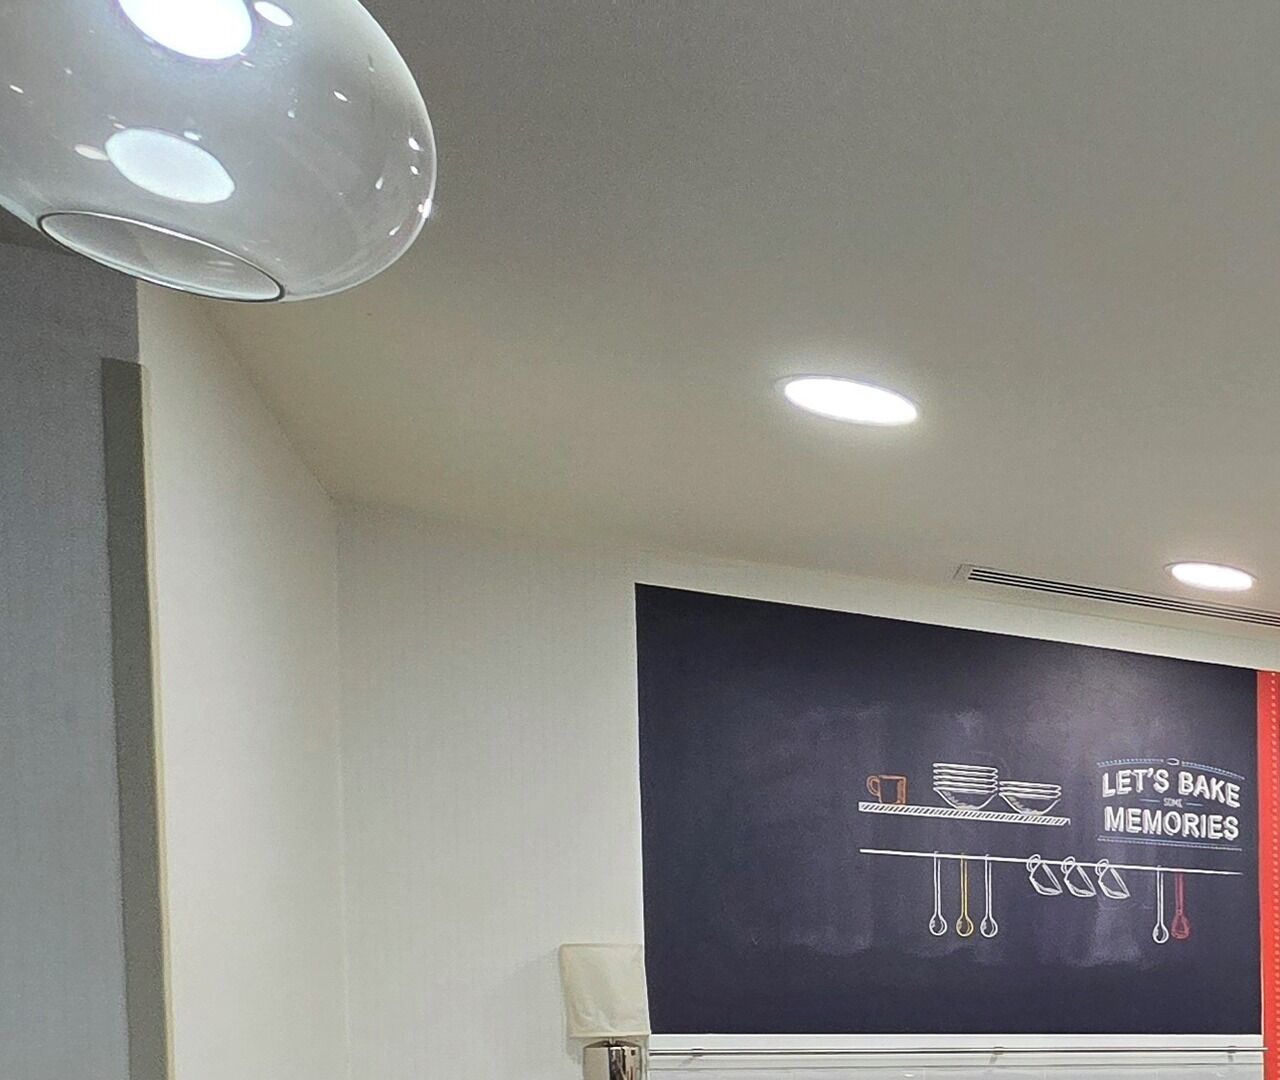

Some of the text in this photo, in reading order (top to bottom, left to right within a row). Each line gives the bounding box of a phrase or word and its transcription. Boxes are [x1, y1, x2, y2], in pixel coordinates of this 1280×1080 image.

[1102, 767, 1241, 808] LET'S BAKE
[1104, 806, 1239, 840] MEMORIES
